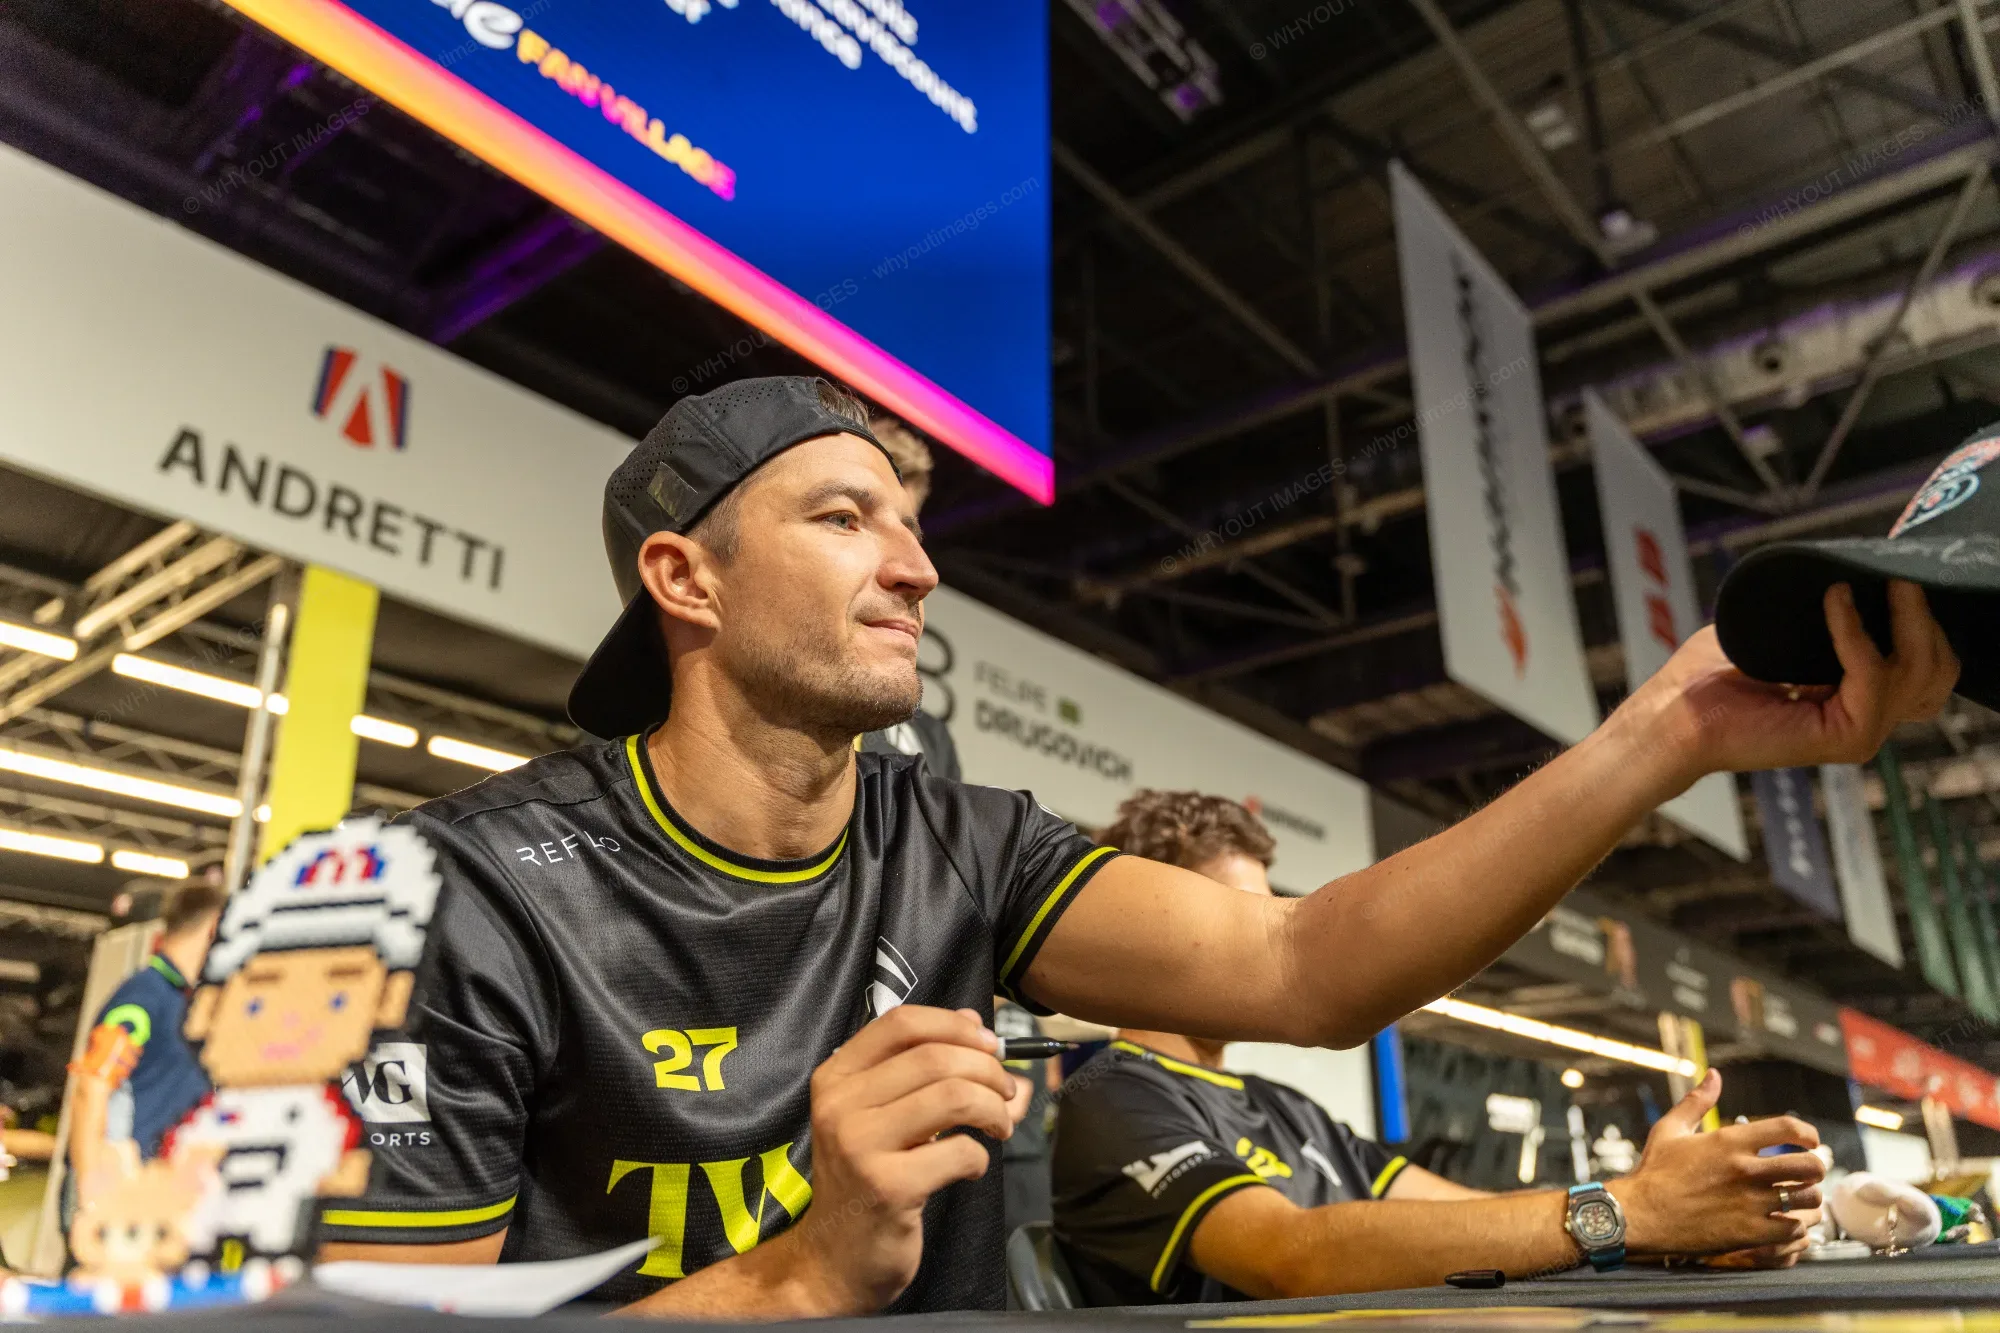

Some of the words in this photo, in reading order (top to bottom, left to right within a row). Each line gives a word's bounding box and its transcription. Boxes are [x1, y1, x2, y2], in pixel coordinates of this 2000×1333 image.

[156, 424, 504, 589] ANDRETTI
[975, 700, 1134, 783] DRUGOVICH
[642, 1026, 738, 1092] 27
[370, 1131, 431, 1147] ORTS
[606, 1141, 814, 1279] TW
